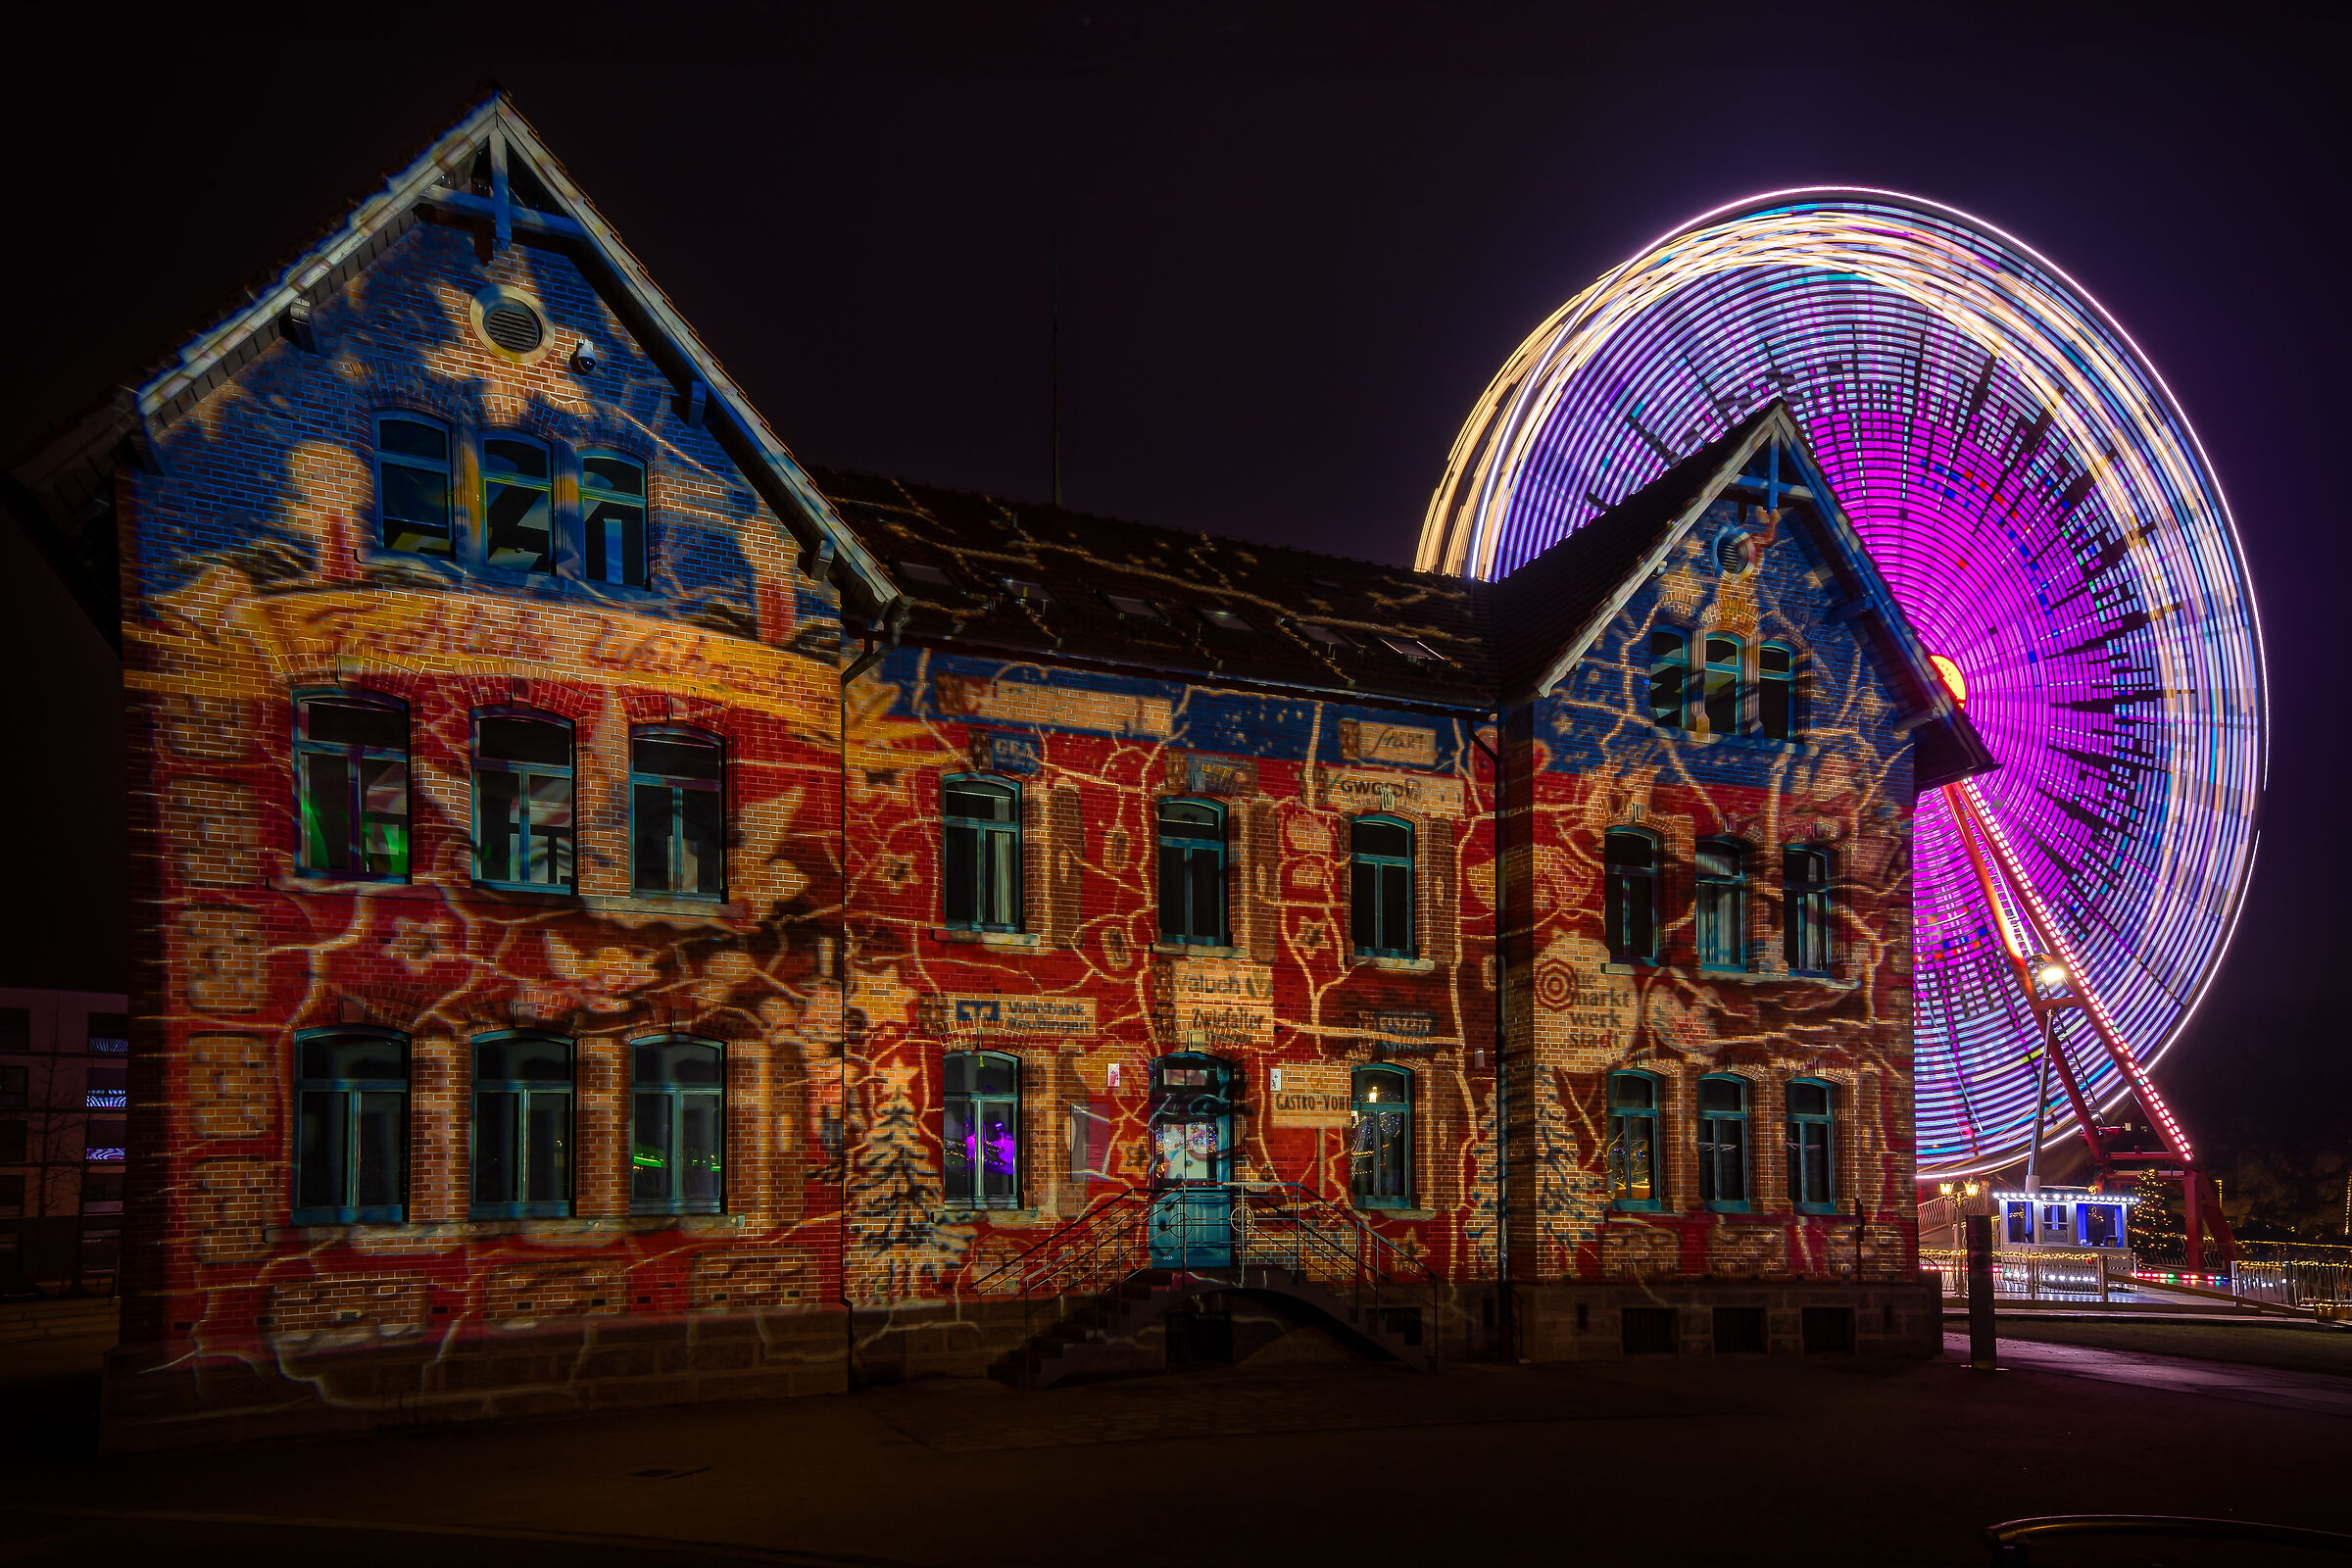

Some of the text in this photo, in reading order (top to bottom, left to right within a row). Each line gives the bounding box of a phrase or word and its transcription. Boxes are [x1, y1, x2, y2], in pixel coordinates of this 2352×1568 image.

[1570, 987, 1630, 1008] markt
[1569, 1008, 1622, 1028] werk
[1569, 1029, 1621, 1048] stadt
